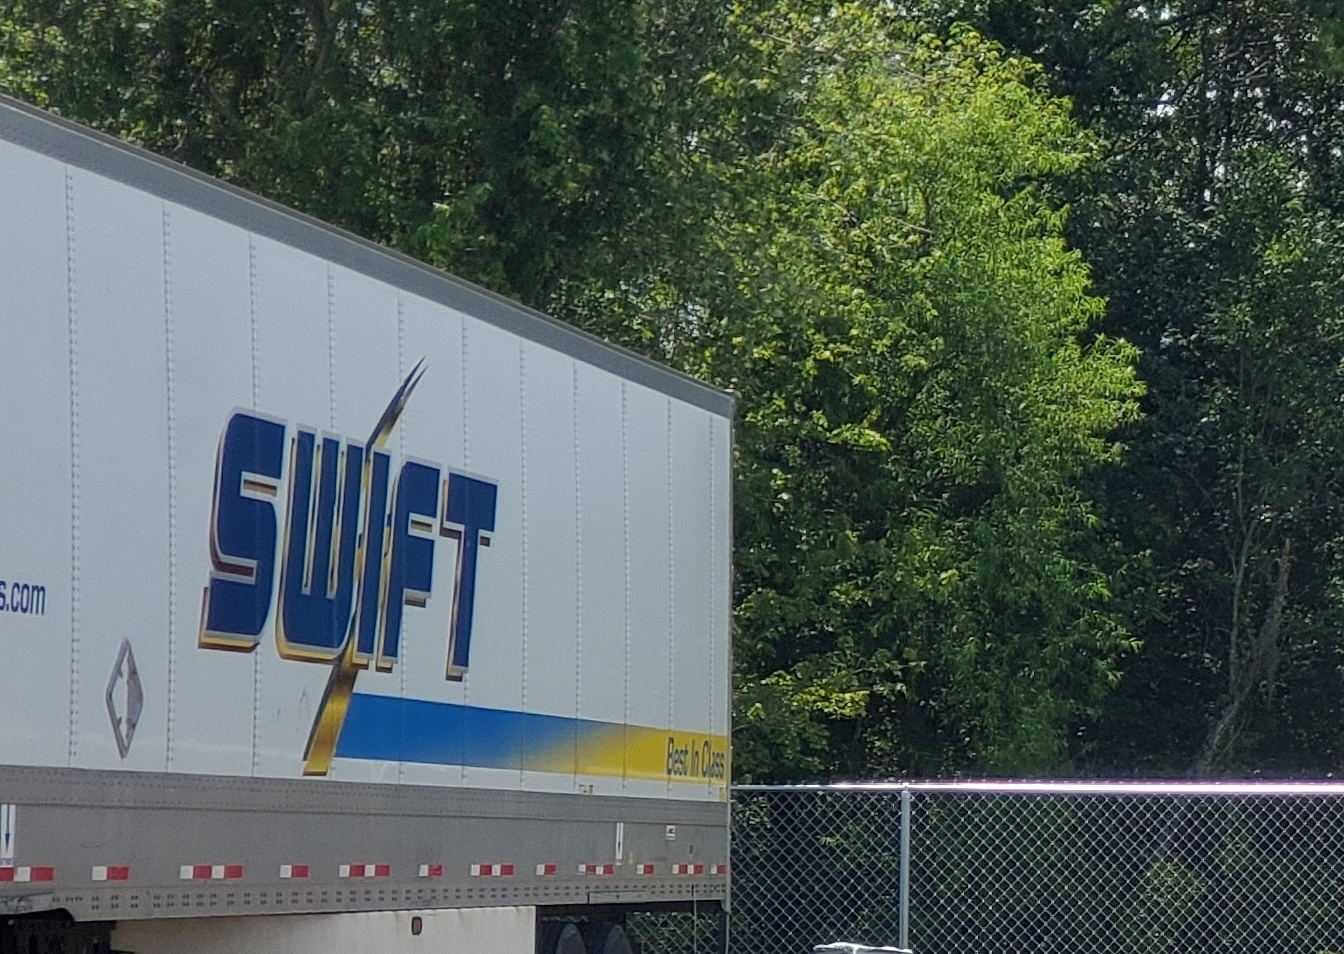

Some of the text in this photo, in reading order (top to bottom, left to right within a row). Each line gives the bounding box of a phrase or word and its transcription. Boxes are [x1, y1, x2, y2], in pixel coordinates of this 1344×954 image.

[199, 407, 498, 681] SWIFT
[667, 736, 688, 775] Best
[702, 740, 725, 778] Class
